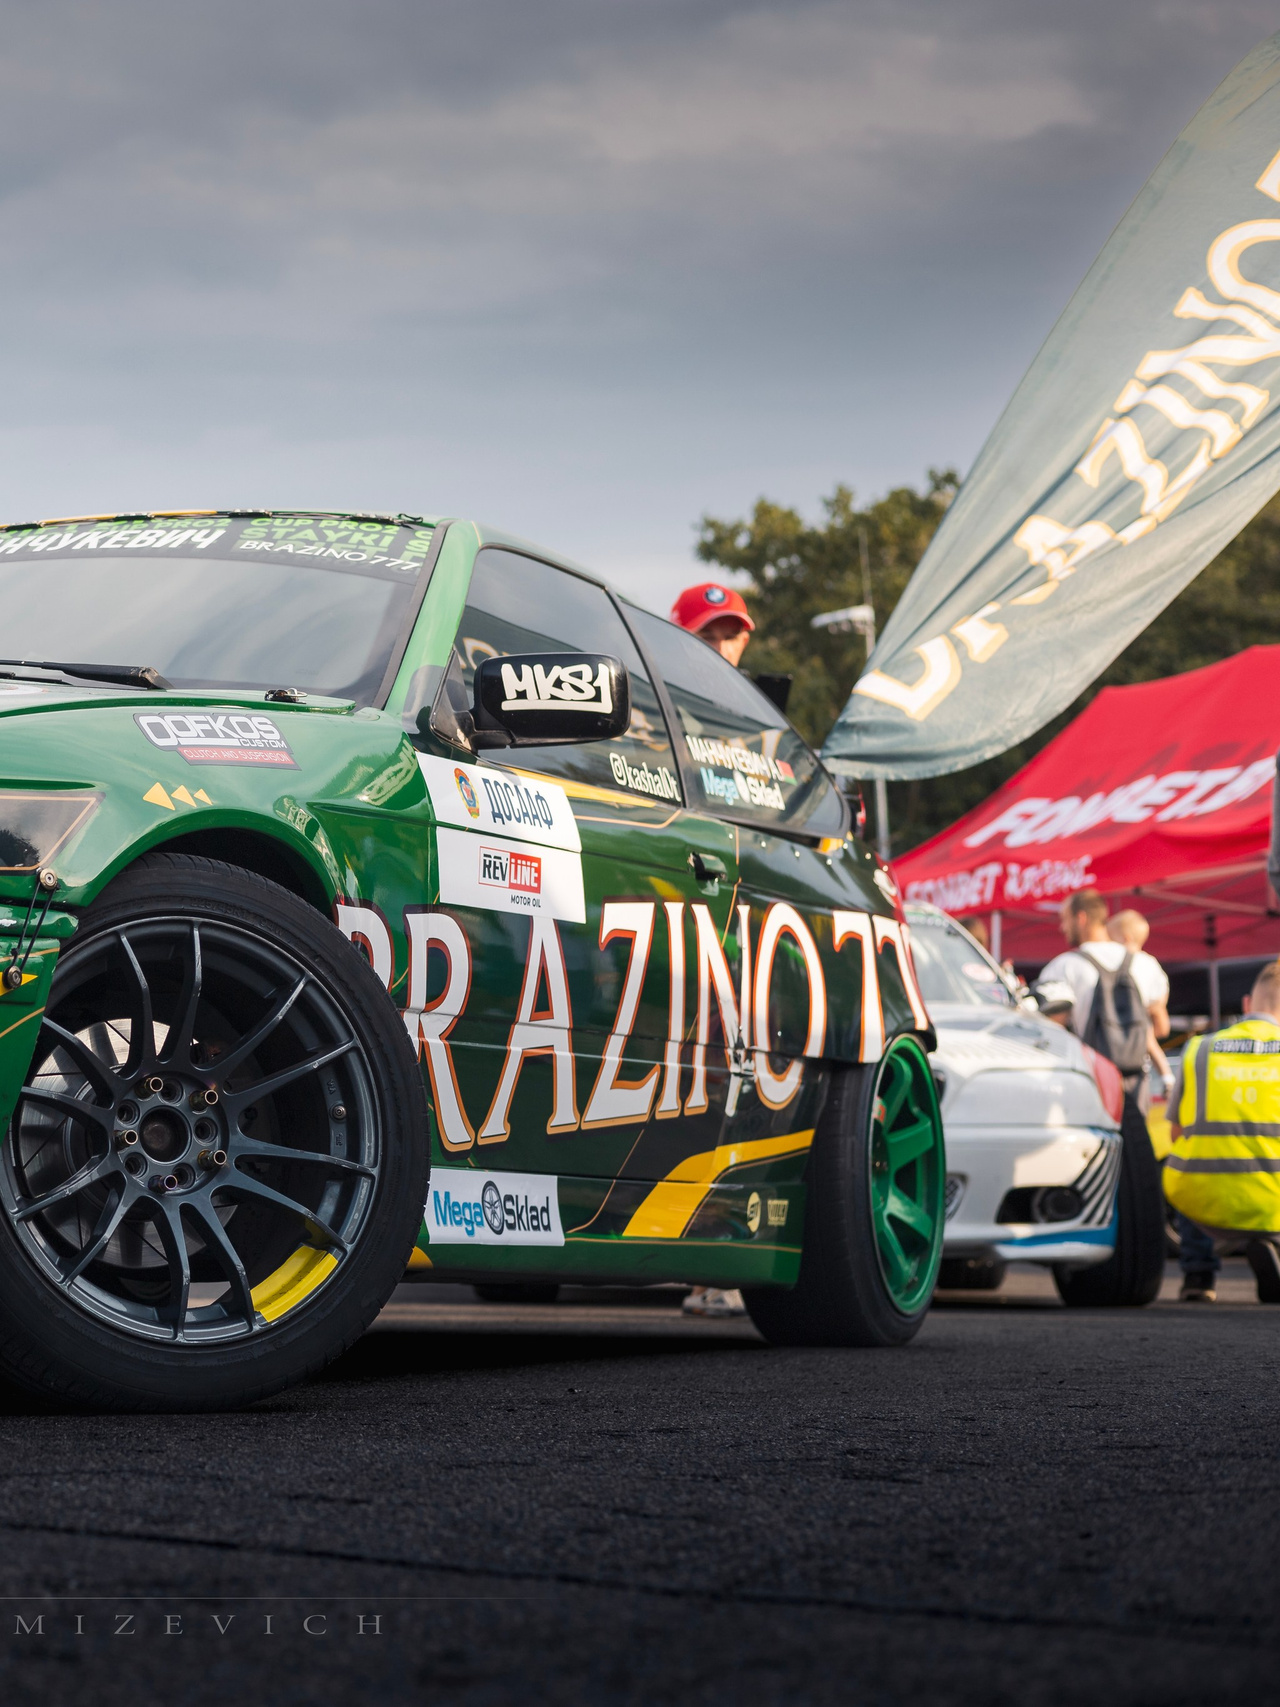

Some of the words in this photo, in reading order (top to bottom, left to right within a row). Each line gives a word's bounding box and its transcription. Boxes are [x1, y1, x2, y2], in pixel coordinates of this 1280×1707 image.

[249, 517, 314, 527] CUP
[318, 519, 401, 535] PRO2
[239, 527, 397, 548] STAYKI
[239, 738, 288, 749] CUSTOM
[182, 749, 221, 759] CLUTCH
[222, 750, 239, 760] AND
[239, 750, 291, 763] SUSPENSION
[481, 777, 554, 830] ДОСААФ
[510, 894, 531, 907] MOTOR
[531, 897, 542, 908] OIL
[432, 1190, 485, 1237] Mega
[502, 1193, 552, 1232] Sklad
